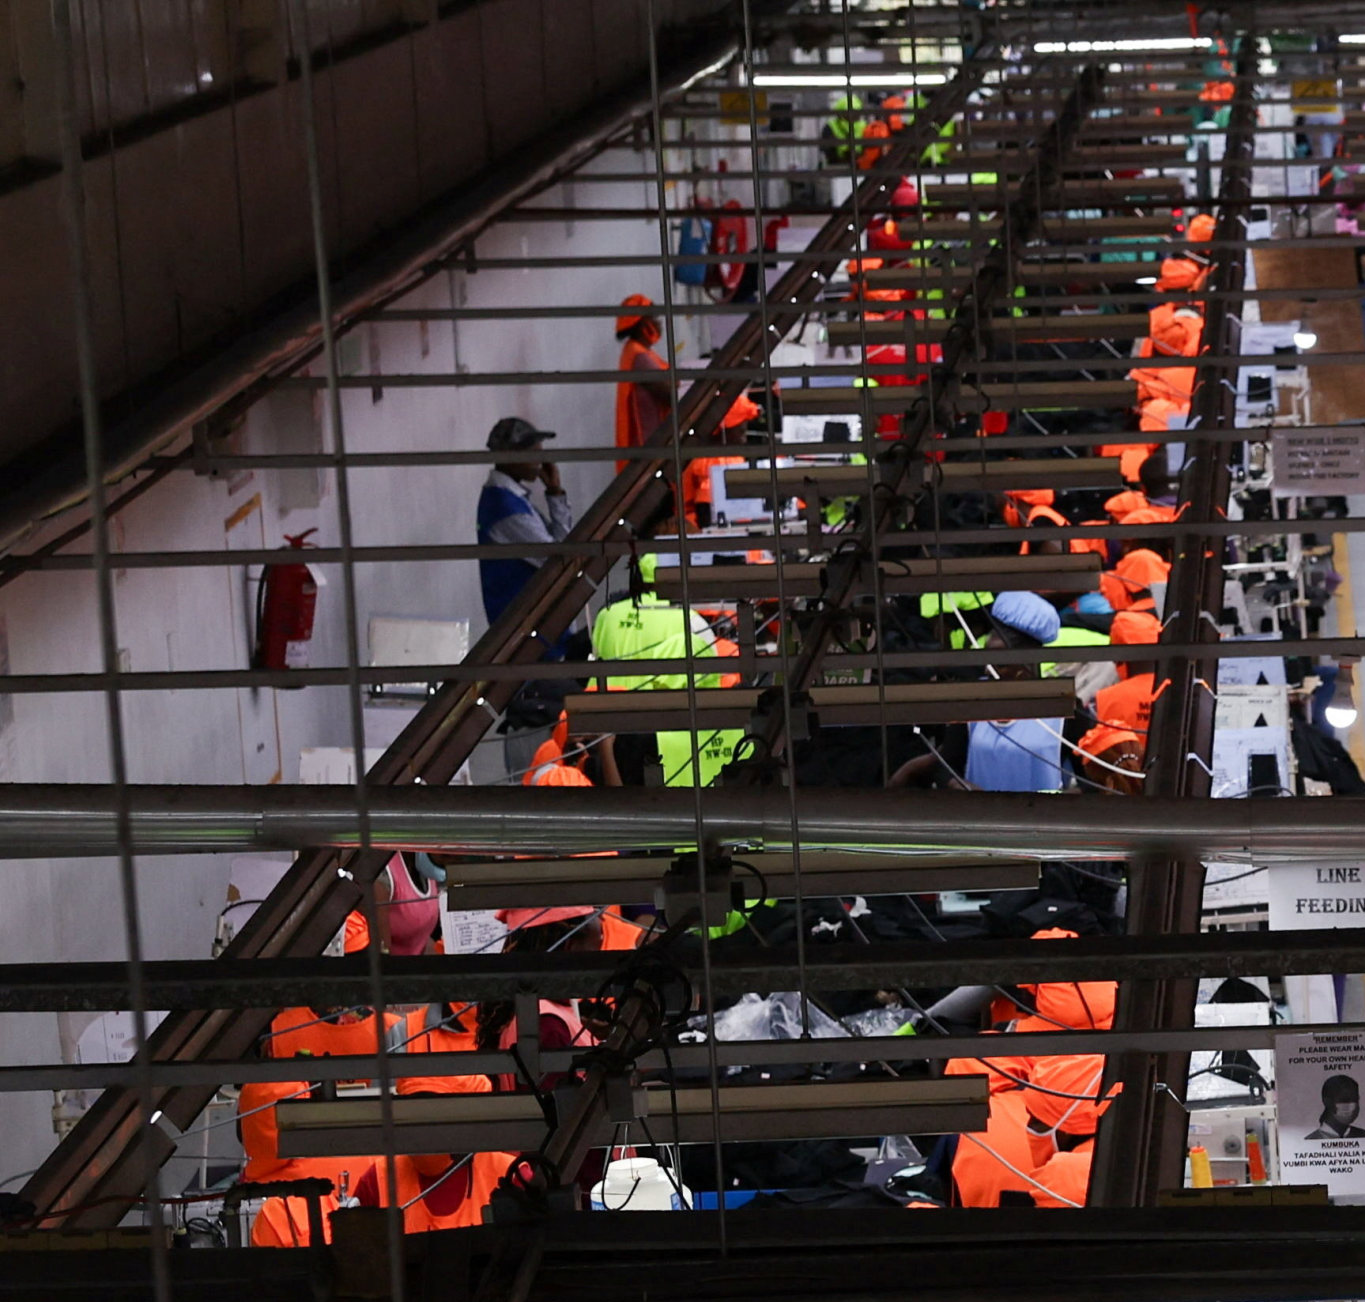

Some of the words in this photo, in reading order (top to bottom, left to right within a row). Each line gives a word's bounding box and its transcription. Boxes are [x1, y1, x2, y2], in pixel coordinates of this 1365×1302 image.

[1316, 868, 1362, 883] LINE
[1329, 1045, 1352, 1053] WEAR
[1306, 1056, 1327, 1064] YOUR
[1328, 1055, 1347, 1063] OWN
[1321, 1140, 1360, 1148] KUMBUKA
[1338, 1150, 1360, 1158] VALIA
[1283, 1160, 1308, 1168] VUMBI
[1309, 1159, 1327, 1167] KWA
[1328, 1158, 1347, 1166] AFYA
[1329, 1166, 1353, 1174] WAKO
